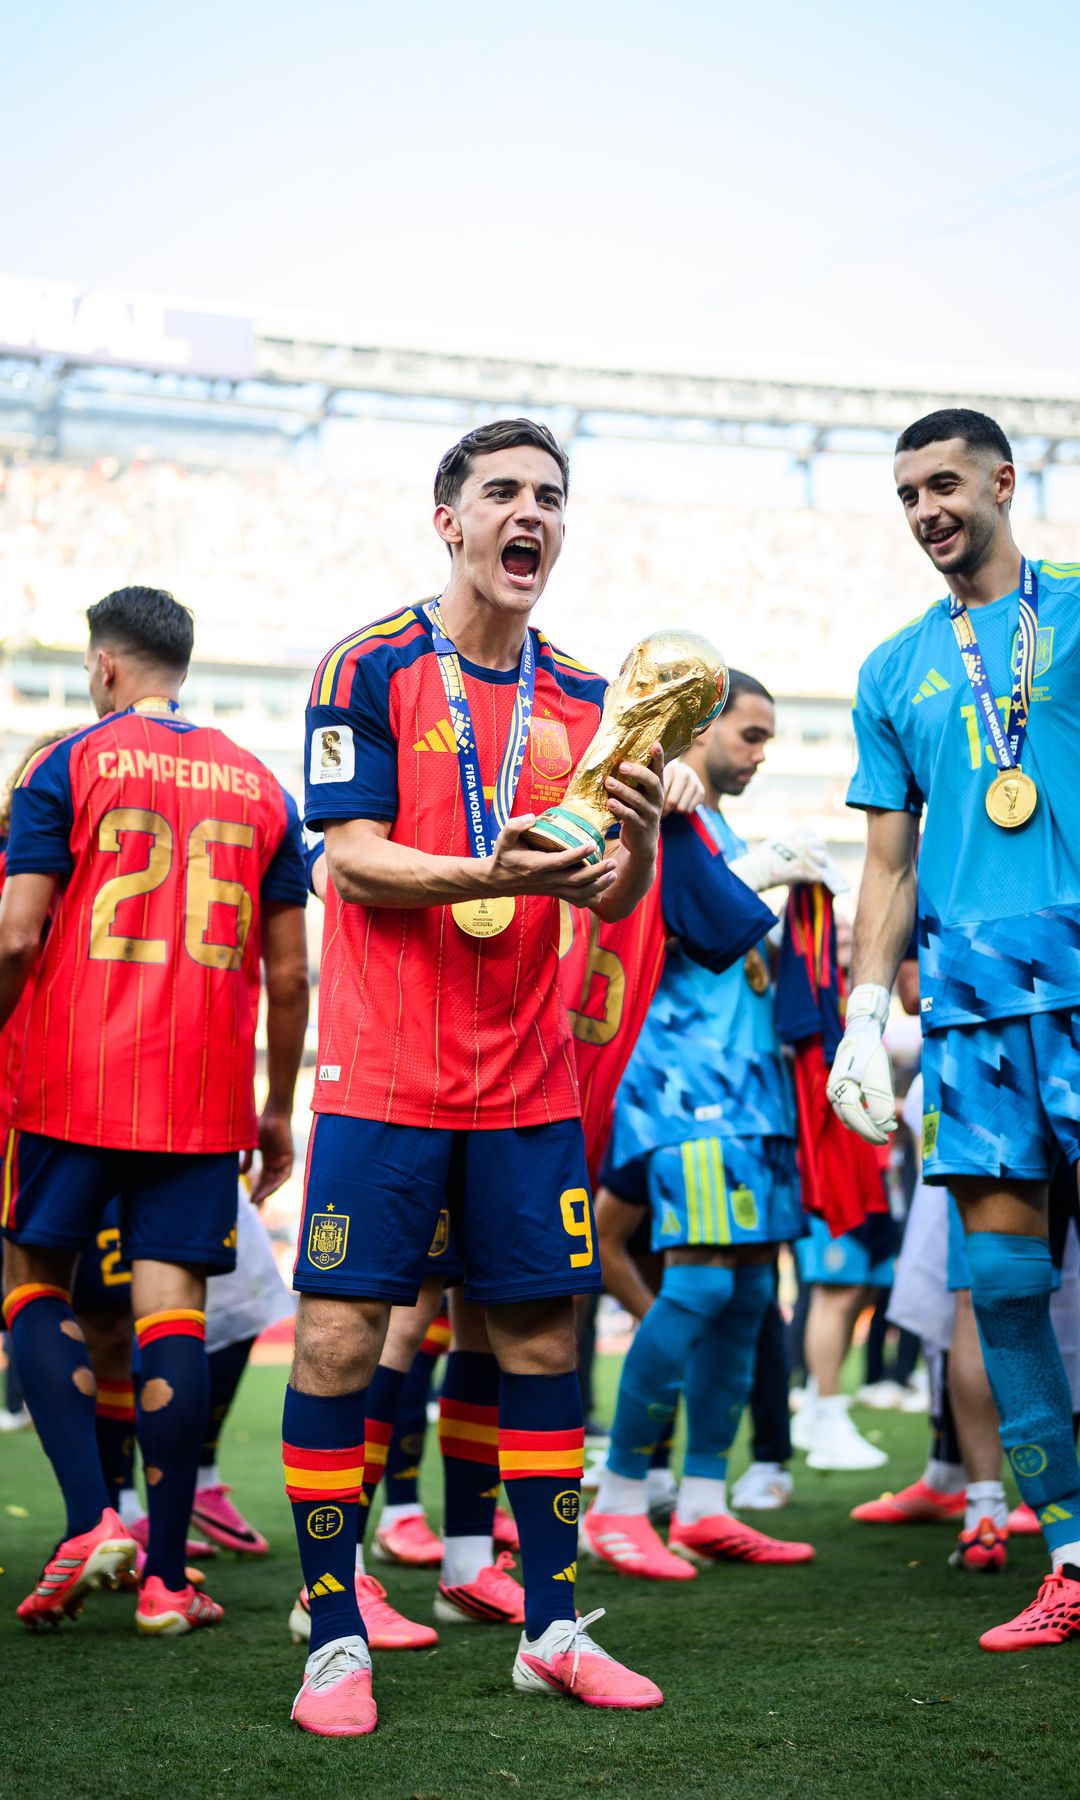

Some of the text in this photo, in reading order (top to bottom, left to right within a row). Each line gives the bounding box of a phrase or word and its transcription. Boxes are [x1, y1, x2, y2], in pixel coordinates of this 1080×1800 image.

[524, 654, 532, 675] FIFA
[981, 692, 1011, 767] FIFA WORLD CUP
[97, 749, 261, 801] CAMPEONES
[465, 763, 487, 858] FIFA WORLD CUP
[88, 806, 256, 971] 26
[560, 1187, 594, 1269] 9
